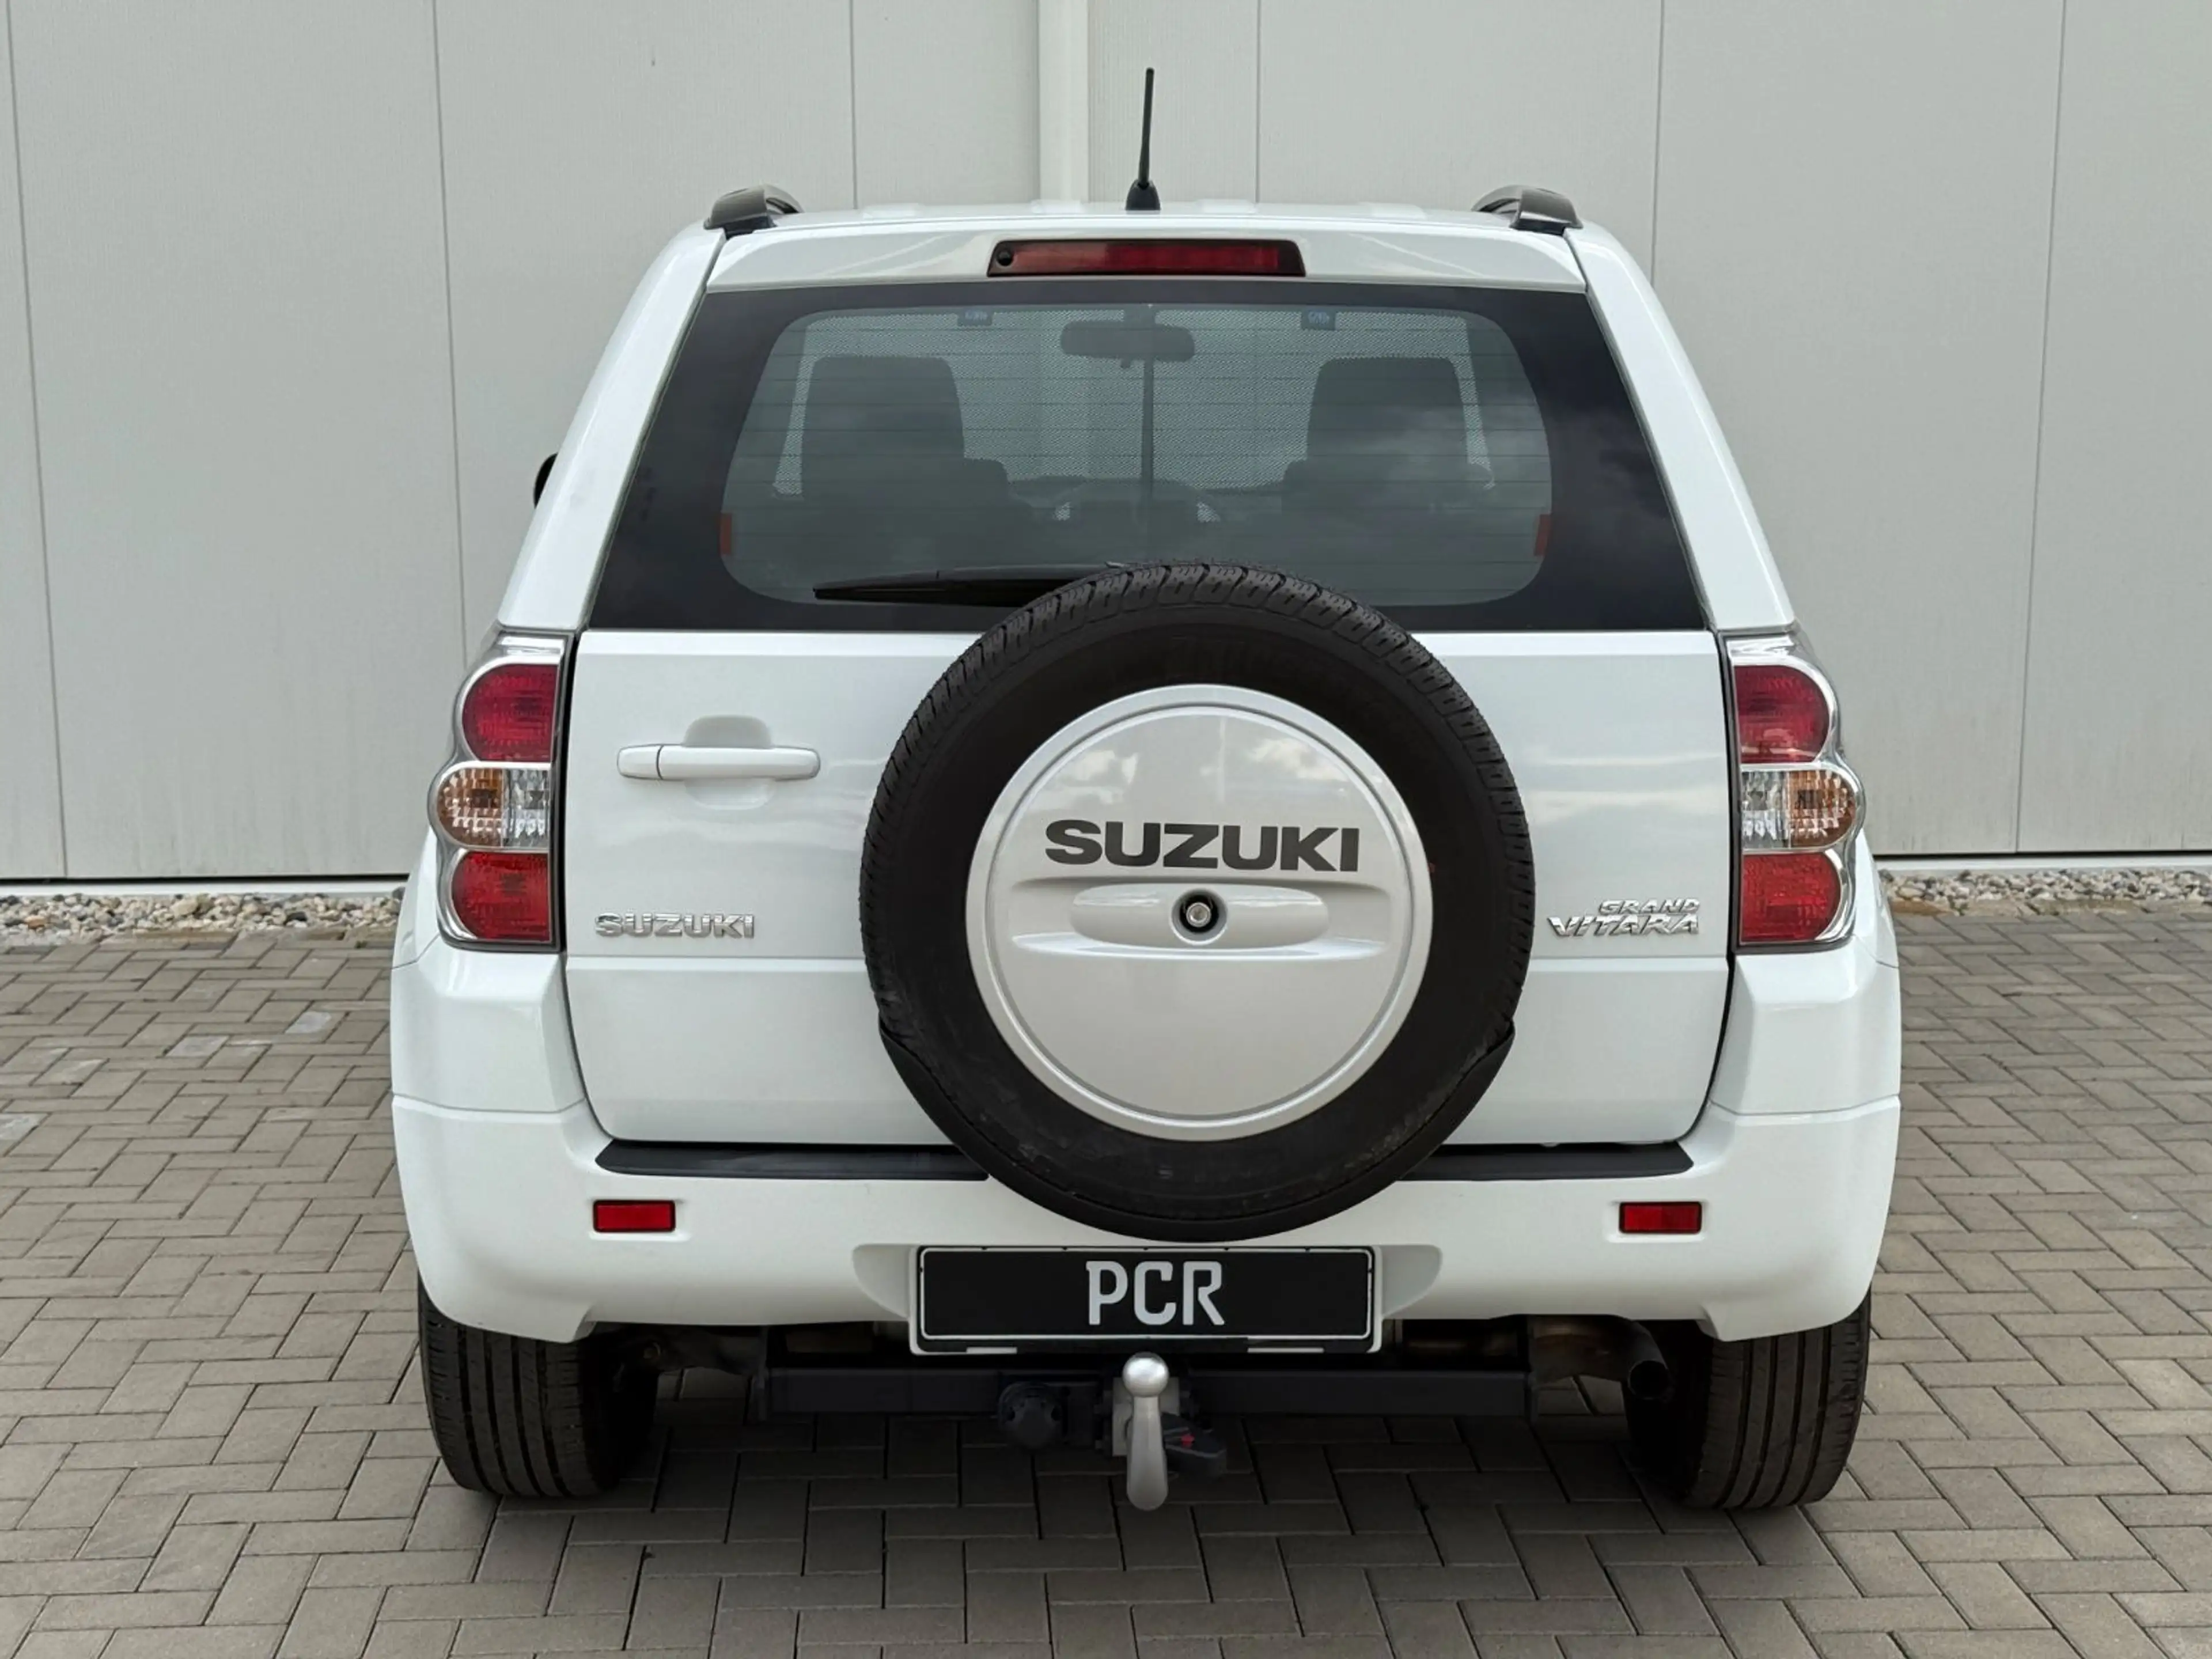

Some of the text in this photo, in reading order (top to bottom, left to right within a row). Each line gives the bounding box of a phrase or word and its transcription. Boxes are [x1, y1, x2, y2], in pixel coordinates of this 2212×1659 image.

[1045, 819, 1359, 872] SUZUKI
[1599, 898, 1700, 915] GRAND
[594, 912, 755, 938] SUZUKI
[1547, 914, 1699, 936] VITARA
[1086, 1260, 1225, 1325] PCR
